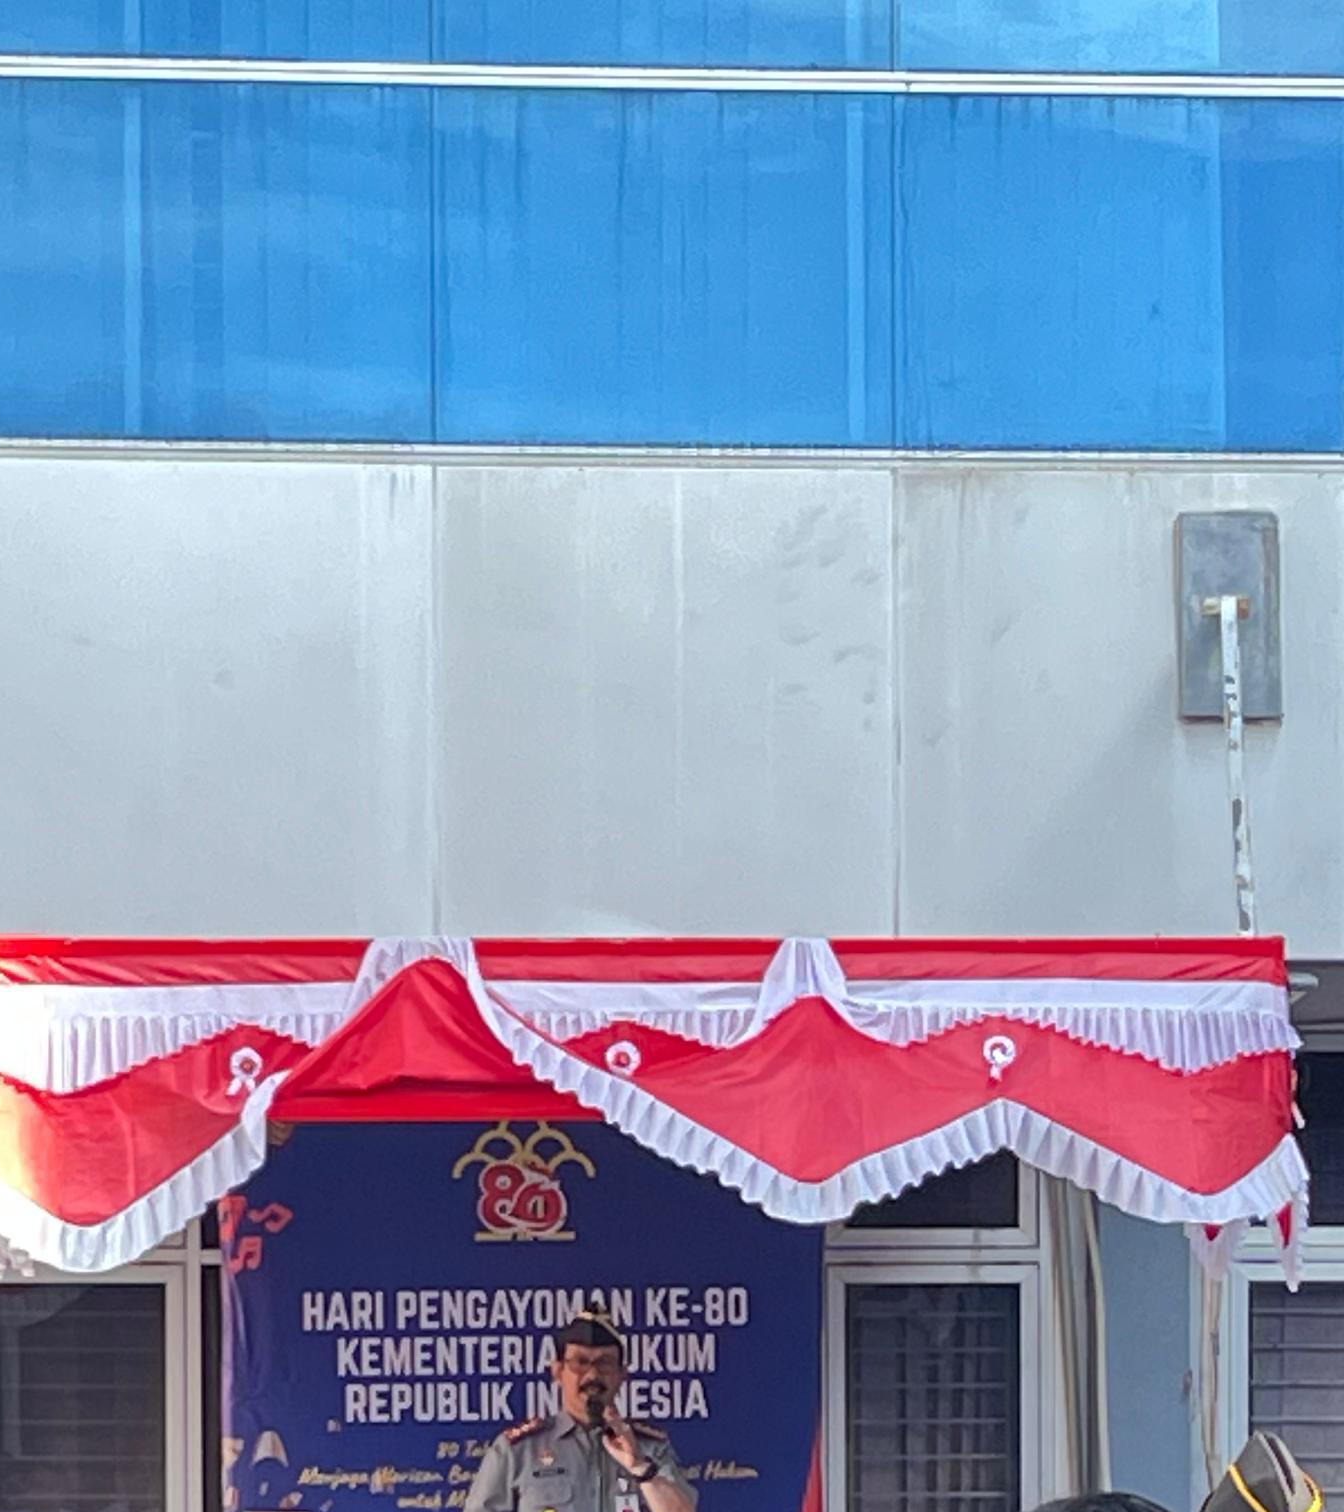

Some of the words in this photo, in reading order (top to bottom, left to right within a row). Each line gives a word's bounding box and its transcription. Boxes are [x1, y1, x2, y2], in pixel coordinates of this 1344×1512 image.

[302, 1290, 383, 1331] HARI
[646, 1287, 749, 1328] KE-80
[337, 1335, 558, 1377] KEMENTERIA
[621, 1333, 716, 1374] UKUM
[345, 1382, 512, 1423] REPUBLIK
[527, 1379, 709, 1420] INNESIA
